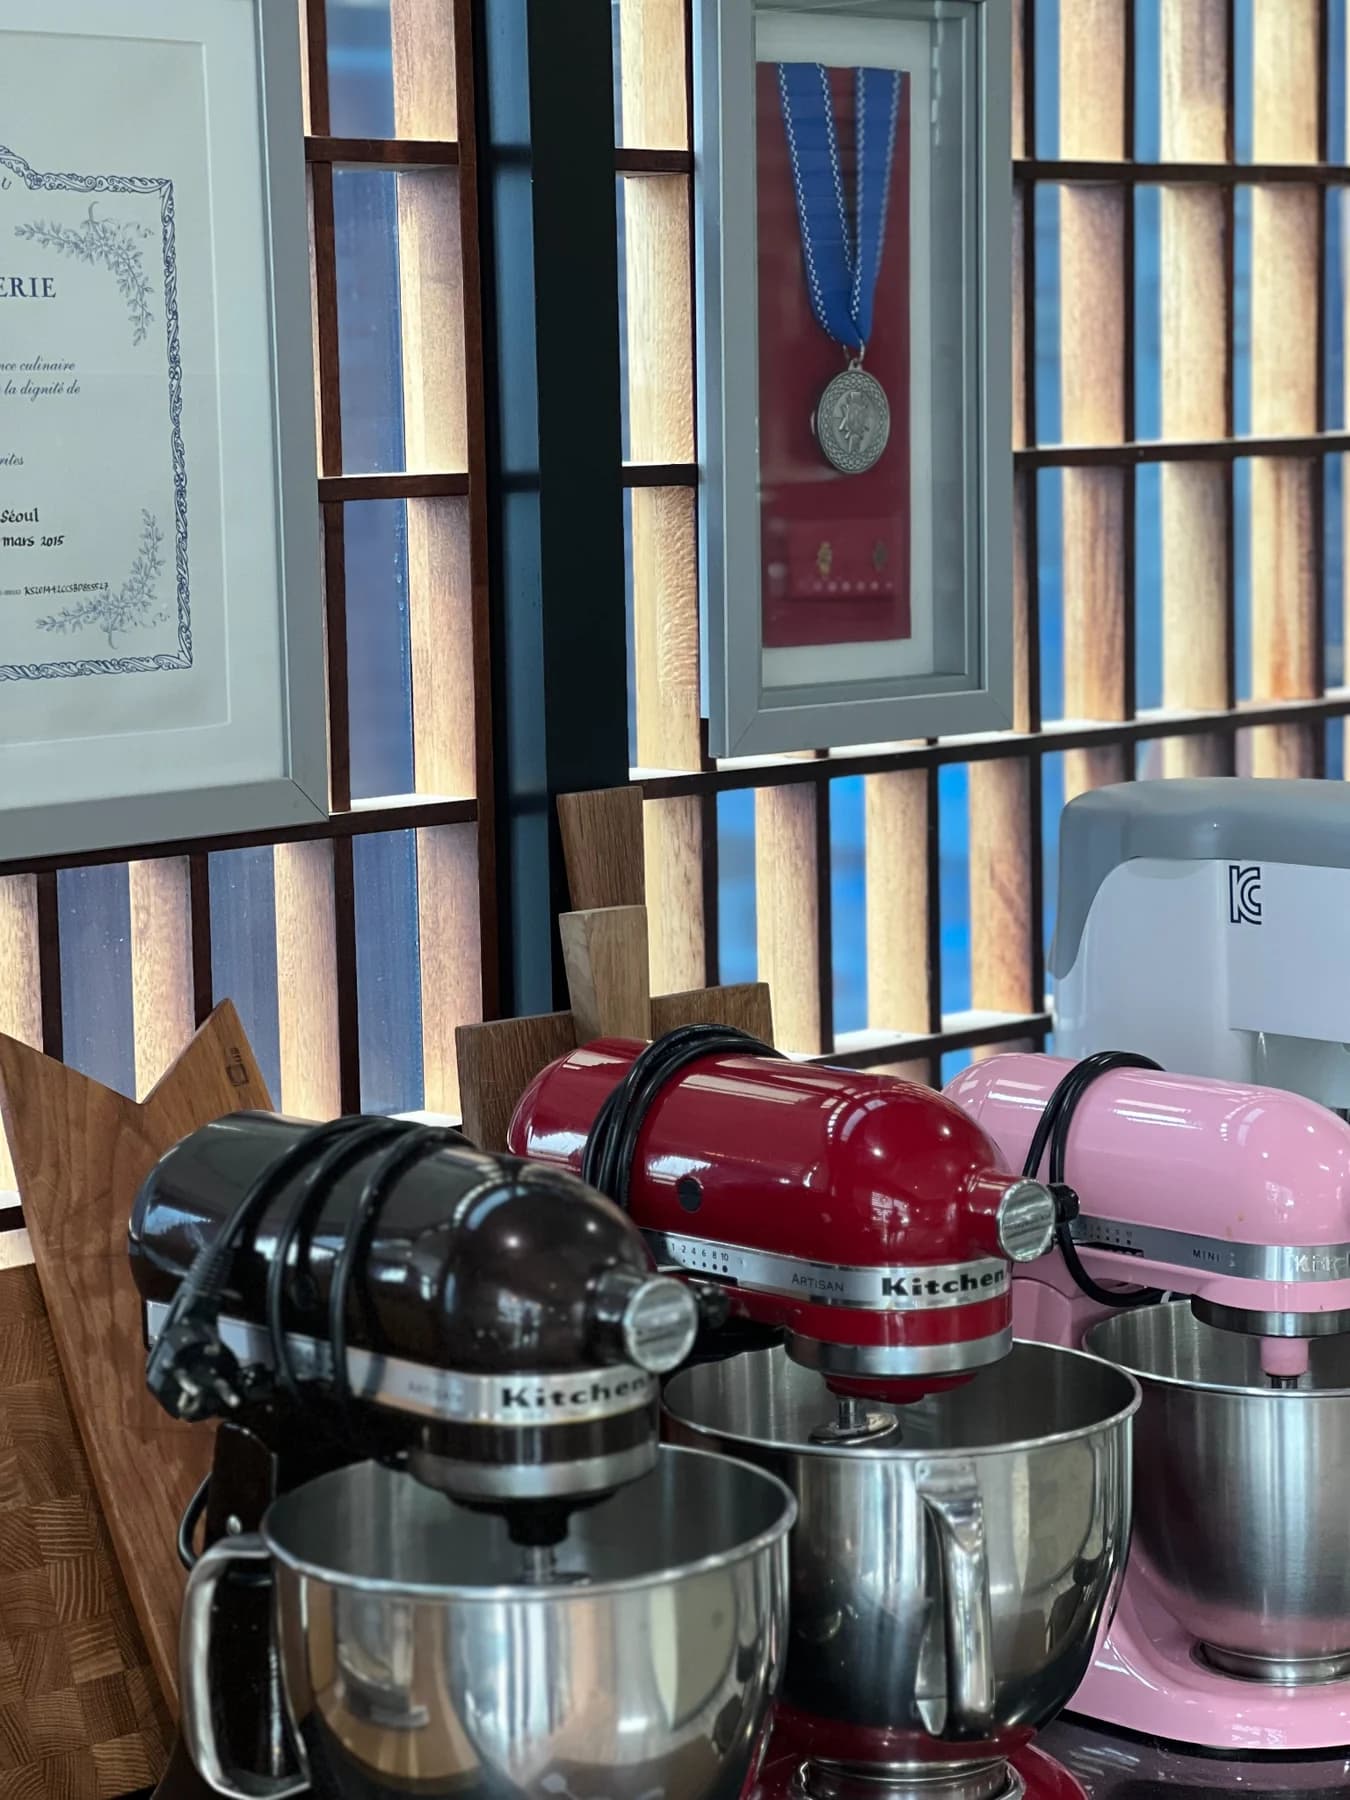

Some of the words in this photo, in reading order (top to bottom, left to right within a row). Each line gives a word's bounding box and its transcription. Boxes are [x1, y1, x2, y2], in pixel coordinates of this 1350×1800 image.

[19, 355, 76, 371] culinaire
[4, 379, 17, 395] la
[20, 379, 64, 402] dignité
[66, 379, 80, 395] de
[0, 507, 40, 523] Séoul
[2, 535, 35, 547] mars
[40, 535, 65, 547] 2015
[720, 1252, 729, 1262] 10
[1192, 1249, 1221, 1262] MINI
[881, 1269, 1004, 1296] Kitchen
[502, 1375, 647, 1408] Kitchen
